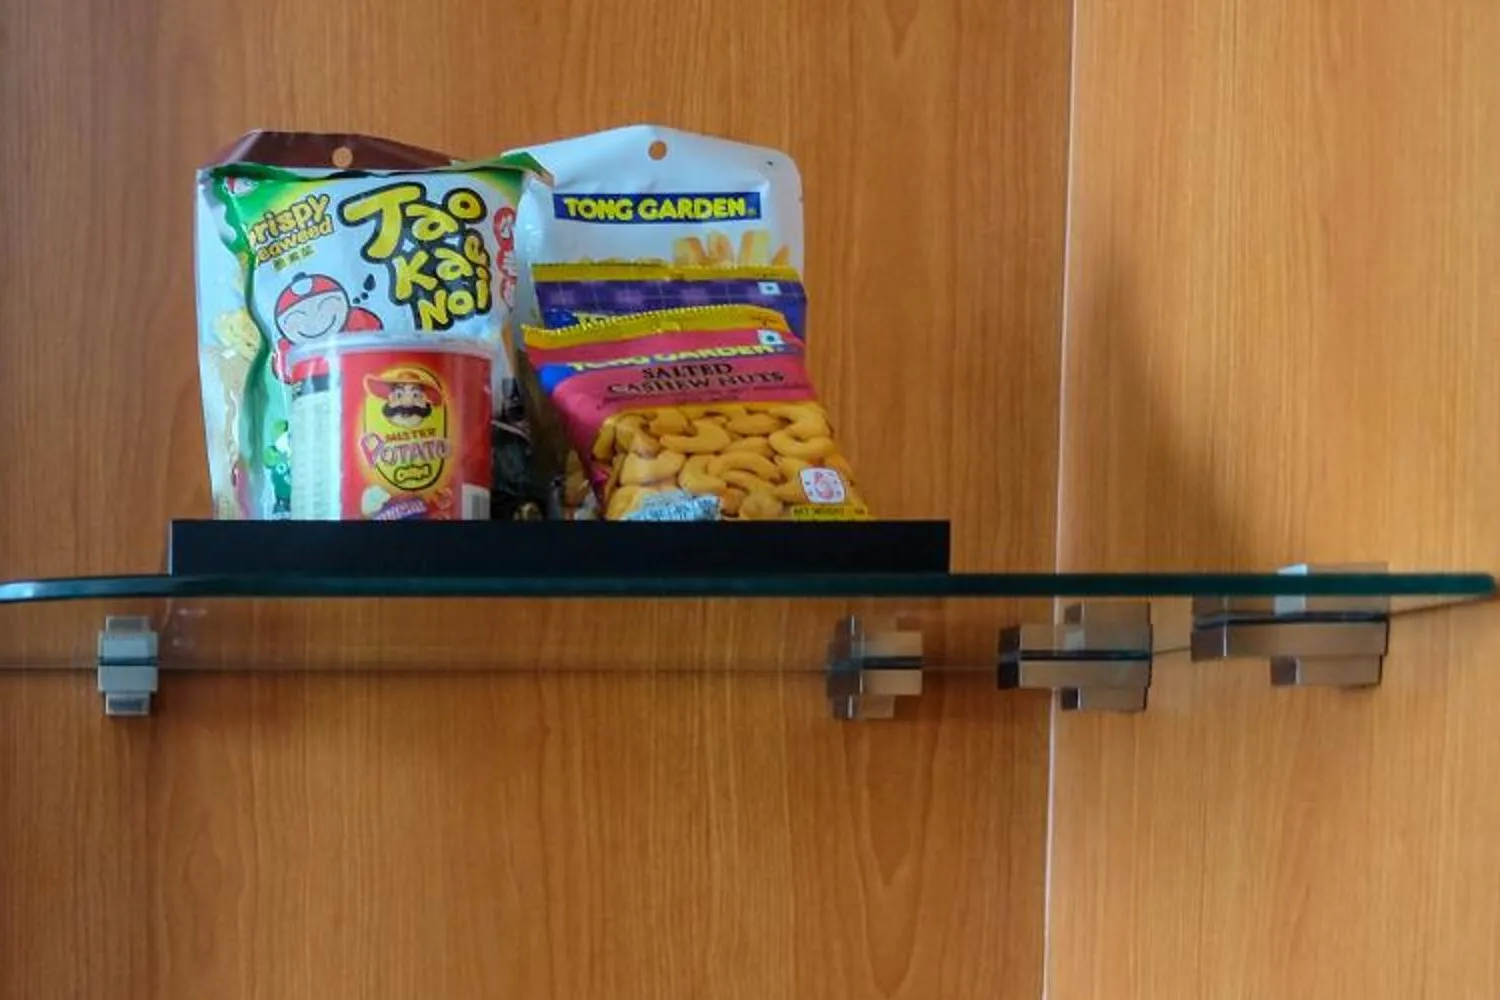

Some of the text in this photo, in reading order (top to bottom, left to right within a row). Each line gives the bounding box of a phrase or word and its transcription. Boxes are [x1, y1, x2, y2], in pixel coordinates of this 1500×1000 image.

[251, 194, 330, 244] rispy
[563, 196, 745, 220] TONG GARDEN
[338, 182, 486, 262] Tao
[642, 363, 733, 379] SALTED
[608, 372, 784, 395] CASHEW NUTS
